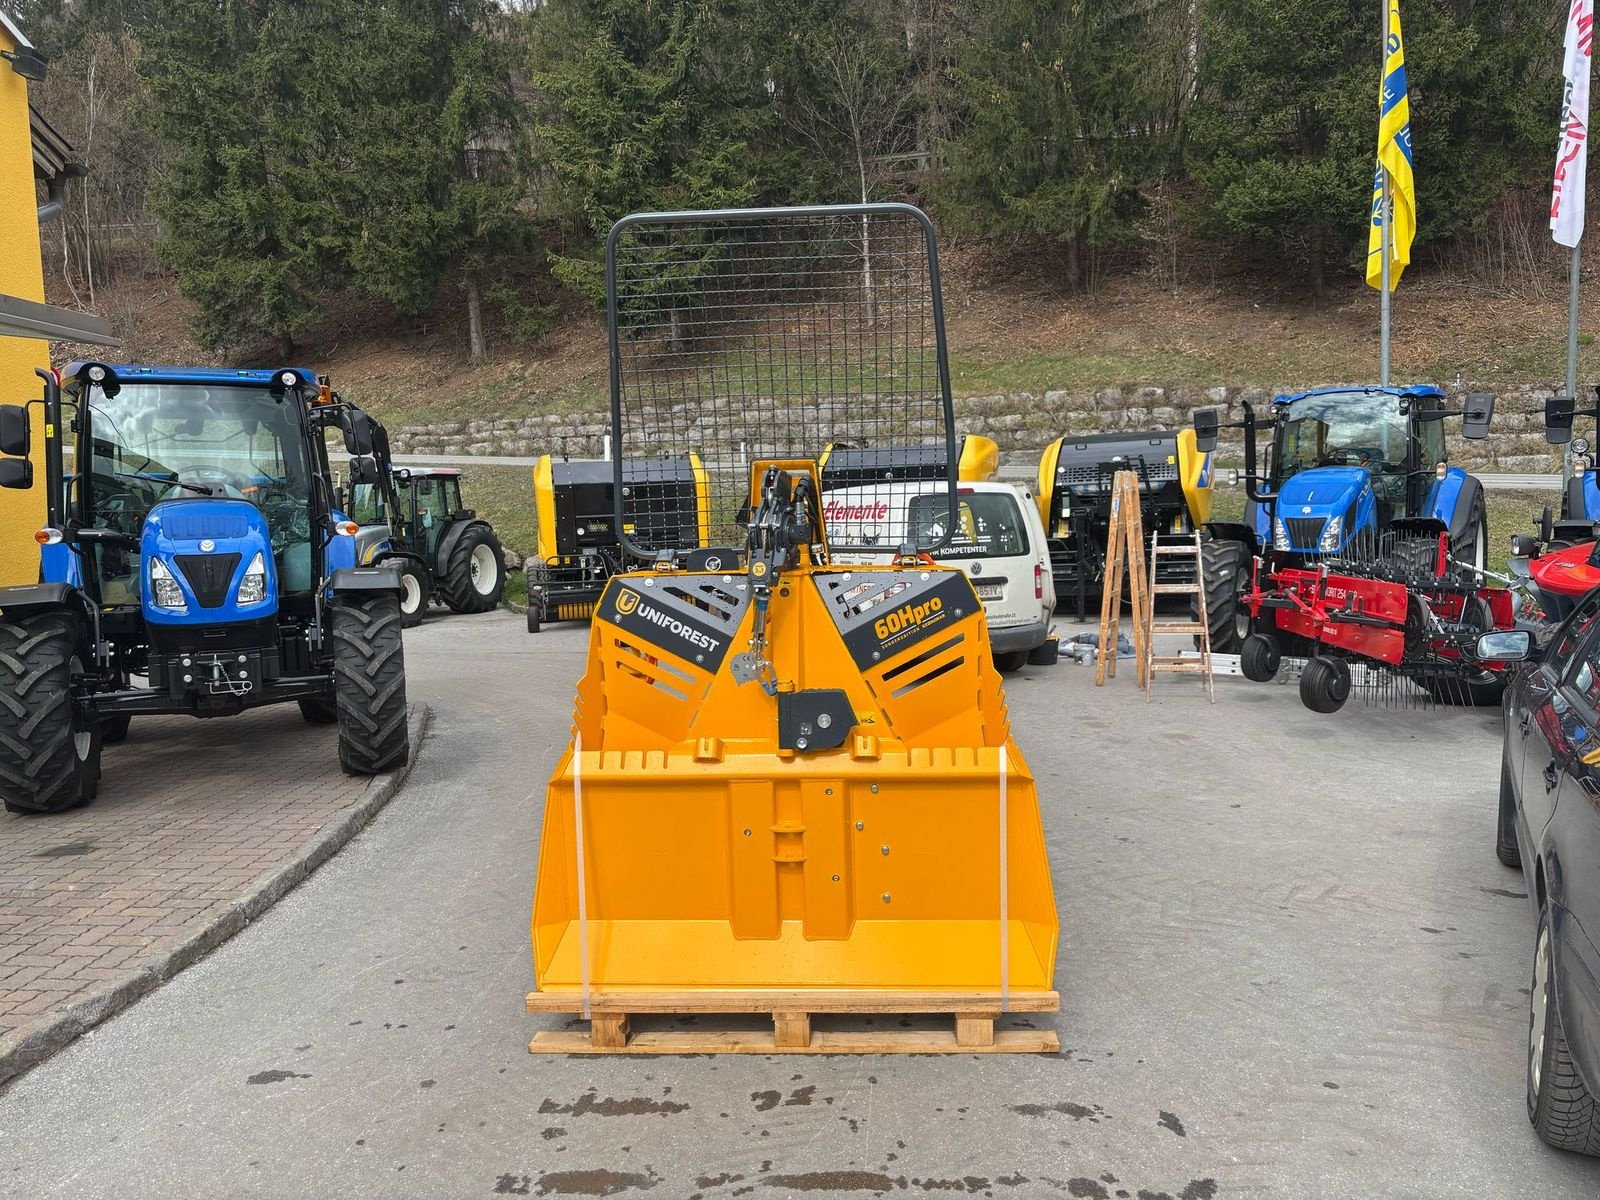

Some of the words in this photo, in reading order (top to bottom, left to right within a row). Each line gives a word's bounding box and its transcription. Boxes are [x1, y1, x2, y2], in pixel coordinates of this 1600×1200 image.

[824, 500, 888, 521] Elemente
[940, 546, 987, 555] KOMPETENTER
[636, 602, 720, 653] UNIFOREST
[874, 596, 943, 640] 60Hpro
